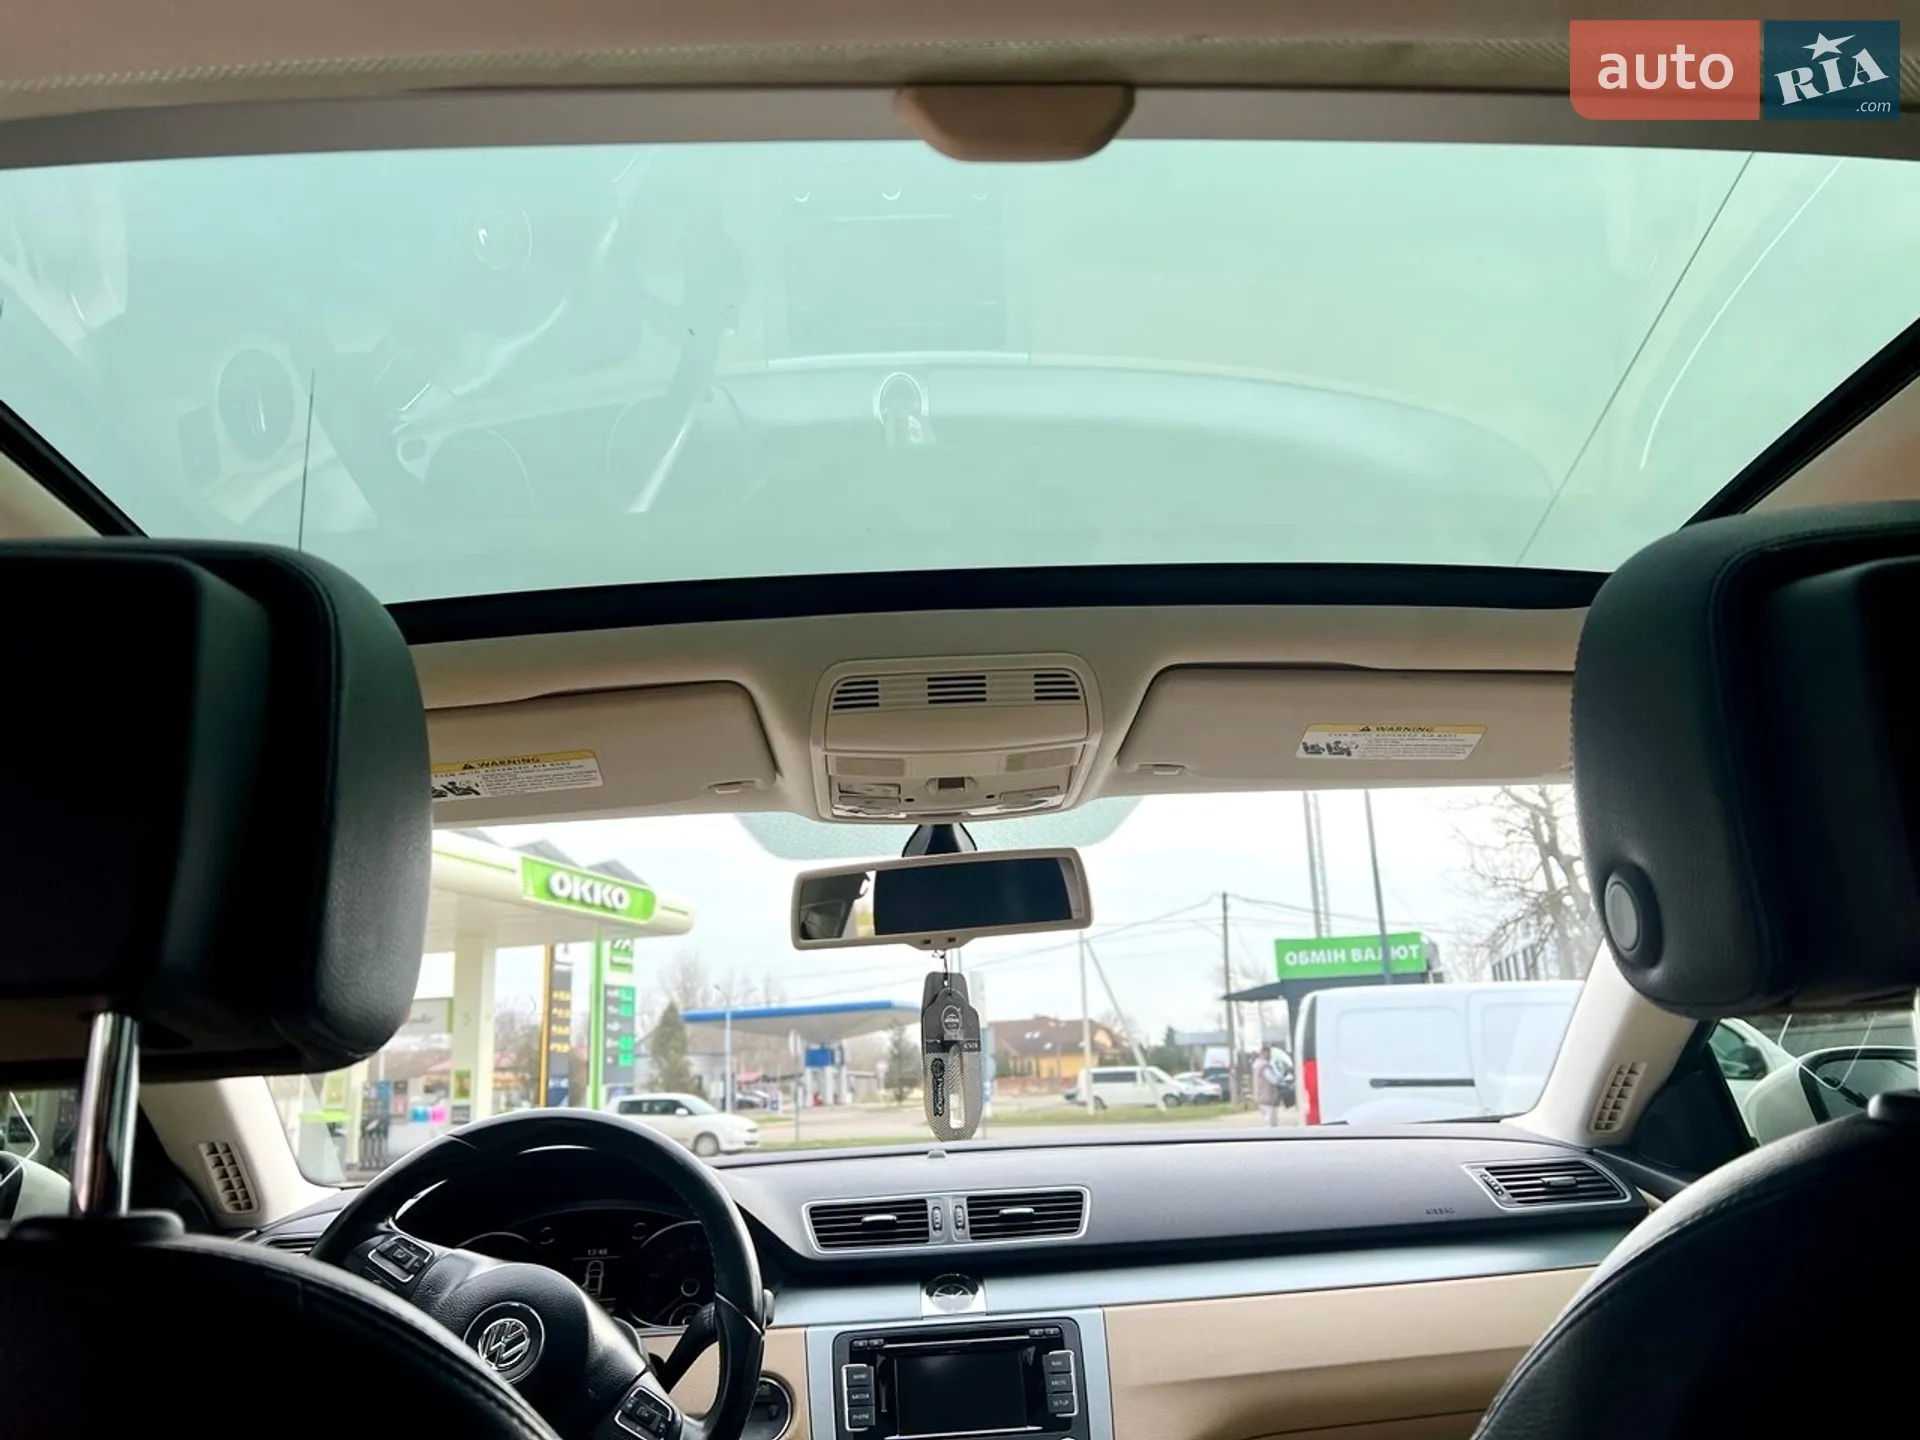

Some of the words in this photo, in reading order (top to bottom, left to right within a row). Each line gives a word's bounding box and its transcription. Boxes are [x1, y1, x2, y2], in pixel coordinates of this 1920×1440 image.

[477, 757, 541, 768] WARNING
[551, 872, 630, 911] OKKO
[1284, 948, 1346, 967] ОБМІН
